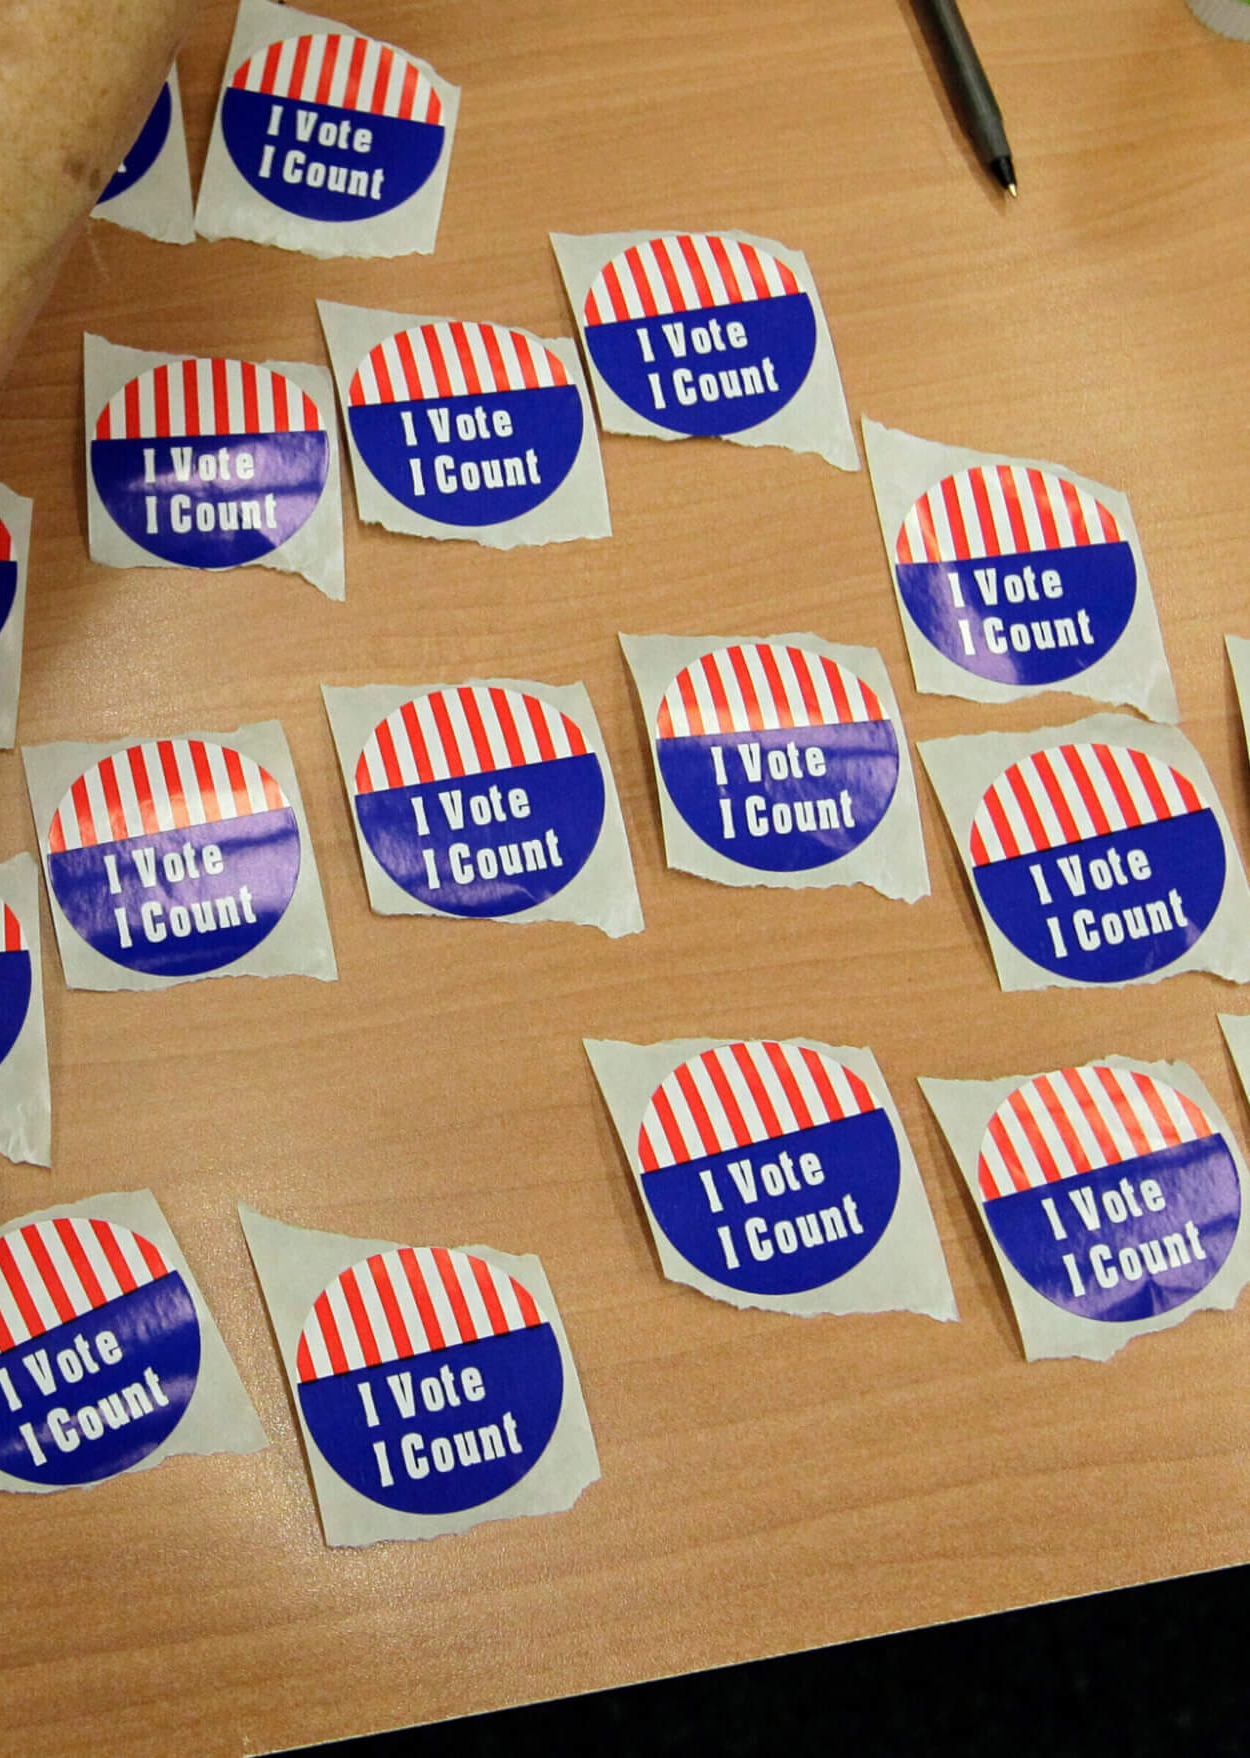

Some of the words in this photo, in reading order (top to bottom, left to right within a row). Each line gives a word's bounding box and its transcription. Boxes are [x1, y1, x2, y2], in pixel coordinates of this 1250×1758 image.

[267, 105, 284, 136] I
[296, 109, 373, 153] Vote
[258, 144, 276, 178] I
[282, 149, 385, 201] Count
[636, 328, 656, 363] I
[661, 319, 748, 358] Vote
[647, 373, 667, 410] I
[672, 357, 779, 406] Count
[400, 411, 418, 447] I
[426, 406, 514, 443] Vote
[143, 448, 157, 484] I
[170, 446, 255, 483] Vote
[409, 458, 426, 497] I
[433, 449, 542, 494] Count
[145, 495, 159, 535] I
[170, 493, 278, 534] Count
[947, 571, 966, 610] I
[973, 565, 1064, 606] Vote
[959, 618, 978, 657] I
[981, 609, 1095, 657] Count
[709, 745, 729, 786] I
[736, 739, 828, 783] Vote
[410, 796, 431, 836] I
[437, 785, 531, 831] Vote
[719, 798, 736, 839] I
[744, 789, 855, 837] Count
[103, 854, 123, 895] I
[131, 841, 225, 889] Vote
[421, 848, 441, 890] I
[448, 829, 564, 885] Count
[1029, 864, 1053, 905] I
[1056, 847, 1152, 897] Vote
[113, 906, 134, 949] I
[141, 884, 258, 944] Count
[1045, 916, 1068, 959] I
[1072, 888, 1189, 952] Count
[698, 1170, 724, 1213] I
[726, 1151, 825, 1204] Vote
[1041, 1197, 1068, 1241] I
[1068, 1178, 1167, 1233] Vote
[717, 1225, 740, 1270] I
[744, 1194, 864, 1261] Count
[1061, 1252, 1087, 1298] I
[1088, 1219, 1207, 1289] Count
[21, 1330, 123, 1396] Vote
[19, 1422, 48, 1466] I
[46, 1366, 170, 1453] Count
[357, 1381, 380, 1427] I
[386, 1364, 486, 1419] Vote
[372, 1440, 395, 1487] I
[400, 1411, 523, 1480] Count
